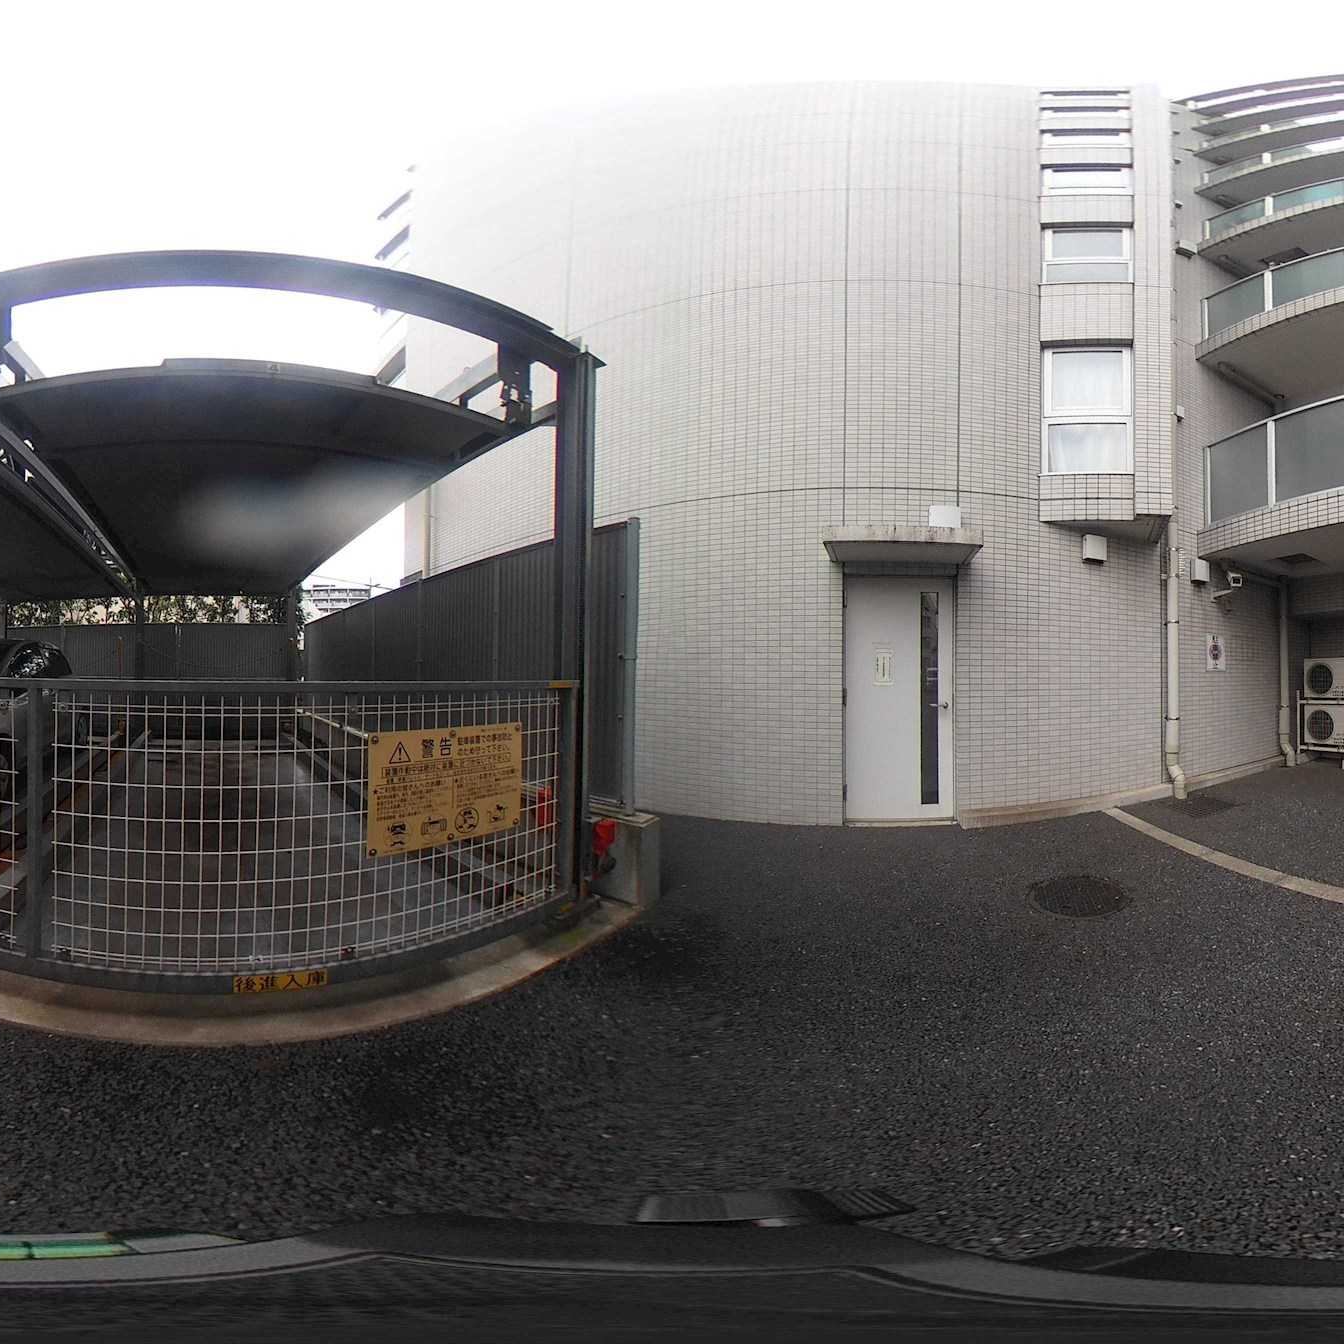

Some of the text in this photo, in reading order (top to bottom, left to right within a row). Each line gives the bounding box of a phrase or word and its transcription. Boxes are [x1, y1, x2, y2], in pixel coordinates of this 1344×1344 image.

[421, 736, 452, 758] 警告
[234, 971, 325, 993] 後進入庫
